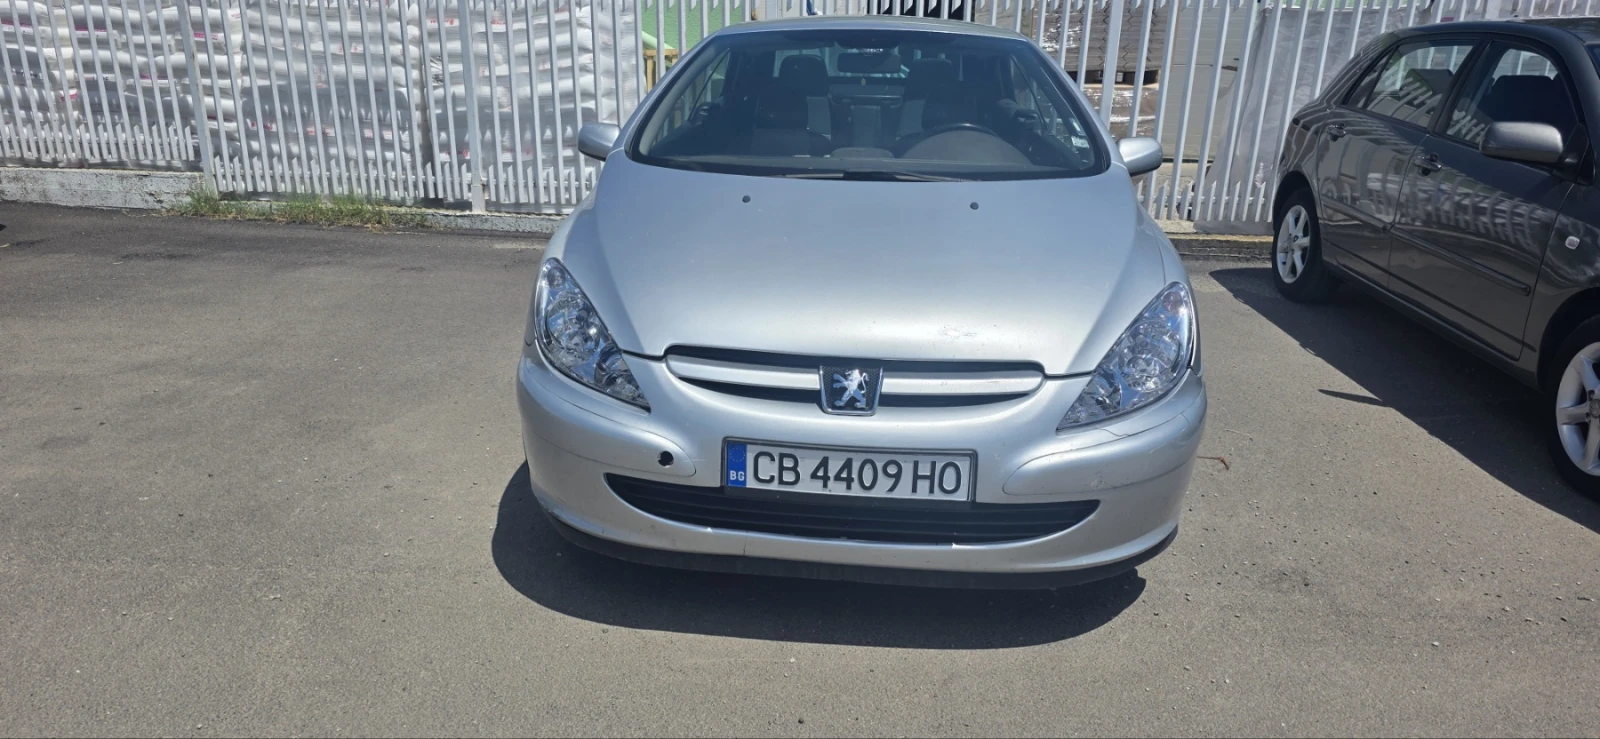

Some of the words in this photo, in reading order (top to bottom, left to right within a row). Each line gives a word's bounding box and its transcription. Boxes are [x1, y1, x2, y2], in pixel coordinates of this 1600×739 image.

[729, 470, 745, 481] BG
[753, 451, 801, 486] CB
[810, 456, 903, 494] 4409
[911, 460, 962, 495] HO
